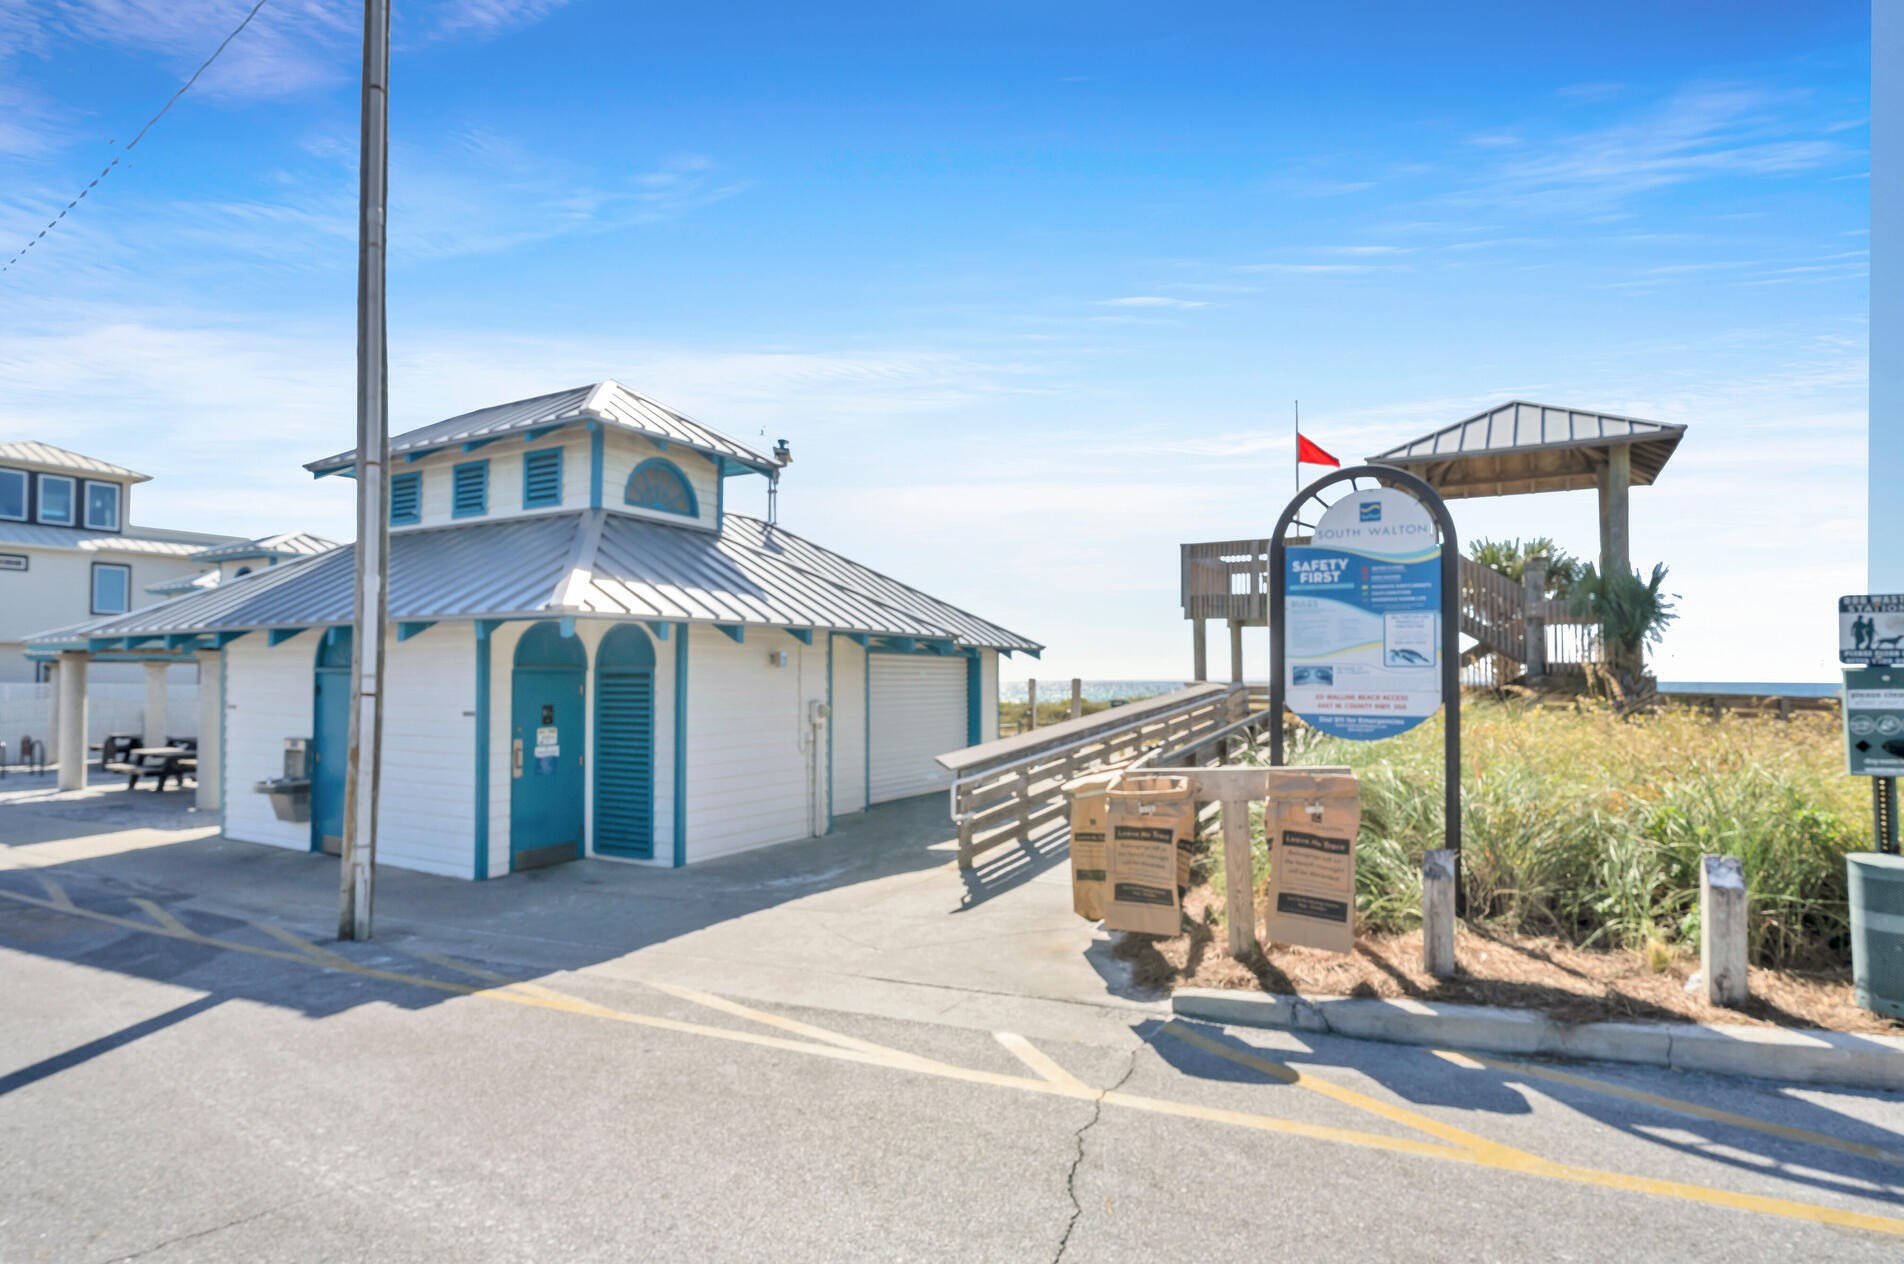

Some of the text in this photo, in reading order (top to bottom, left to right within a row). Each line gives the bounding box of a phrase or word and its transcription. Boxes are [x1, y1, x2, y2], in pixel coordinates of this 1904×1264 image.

[1318, 523, 1428, 540] SOUTH WALTON
[1291, 558, 1349, 572] SAFETY
[1299, 571, 1341, 584] FIRST
[1843, 596, 1868, 605] DOG
[1117, 830, 1140, 838] Leave
[1285, 833, 1309, 844] Leave
[1323, 841, 1346, 851] Trace
